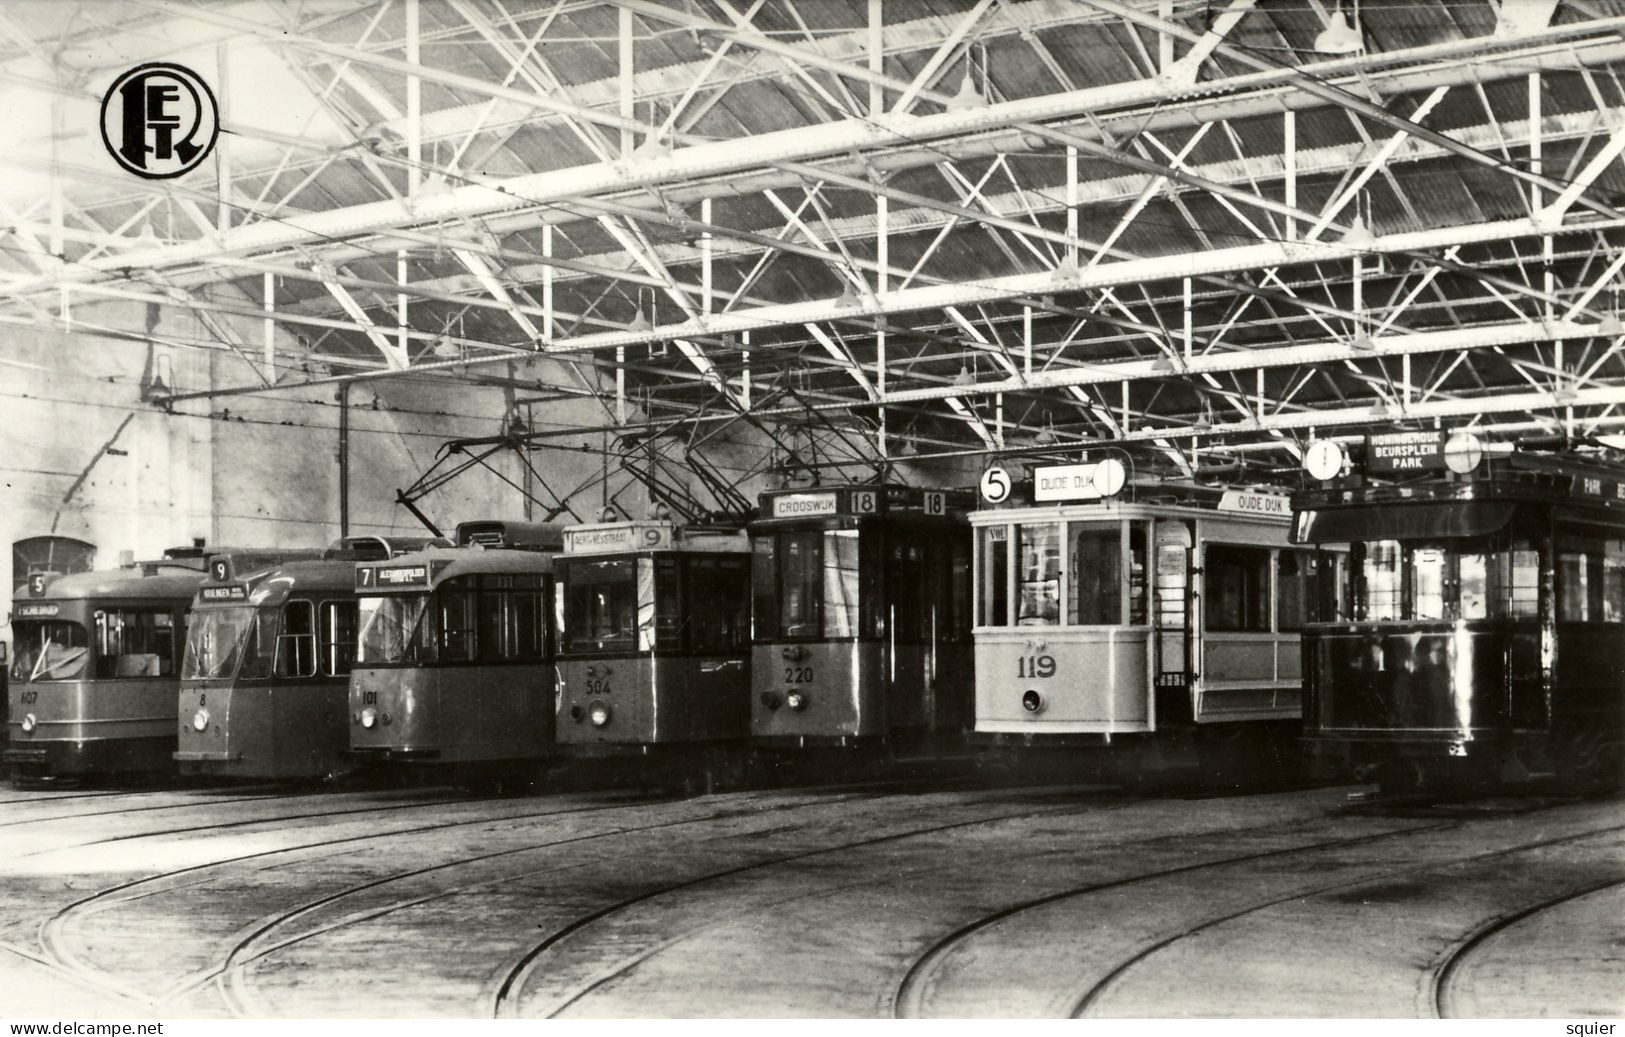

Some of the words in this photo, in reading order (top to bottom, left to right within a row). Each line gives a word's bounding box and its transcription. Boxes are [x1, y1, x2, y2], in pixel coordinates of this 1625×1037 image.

[1375, 443, 1438, 458] BEURSPLEIN
[1392, 457, 1423, 470] PARK
[987, 470, 1006, 500] 5
[1041, 476, 1068, 490] OUDE
[1583, 477, 1601, 495] PARK
[851, 493, 873, 512] 18
[927, 493, 942, 514] 18
[1238, 495, 1263, 511] OUDE
[644, 529, 661, 546] 9
[217, 563, 225, 579] 9
[362, 568, 371, 586] 7
[35, 576, 45, 592] 5
[1017, 654, 1057, 679] 119
[784, 666, 813, 684] 220
[586, 680, 611, 695] 504
[21, 691, 38, 705] 607
[200, 694, 206, 707] 8
[362, 691, 377, 705] 101
